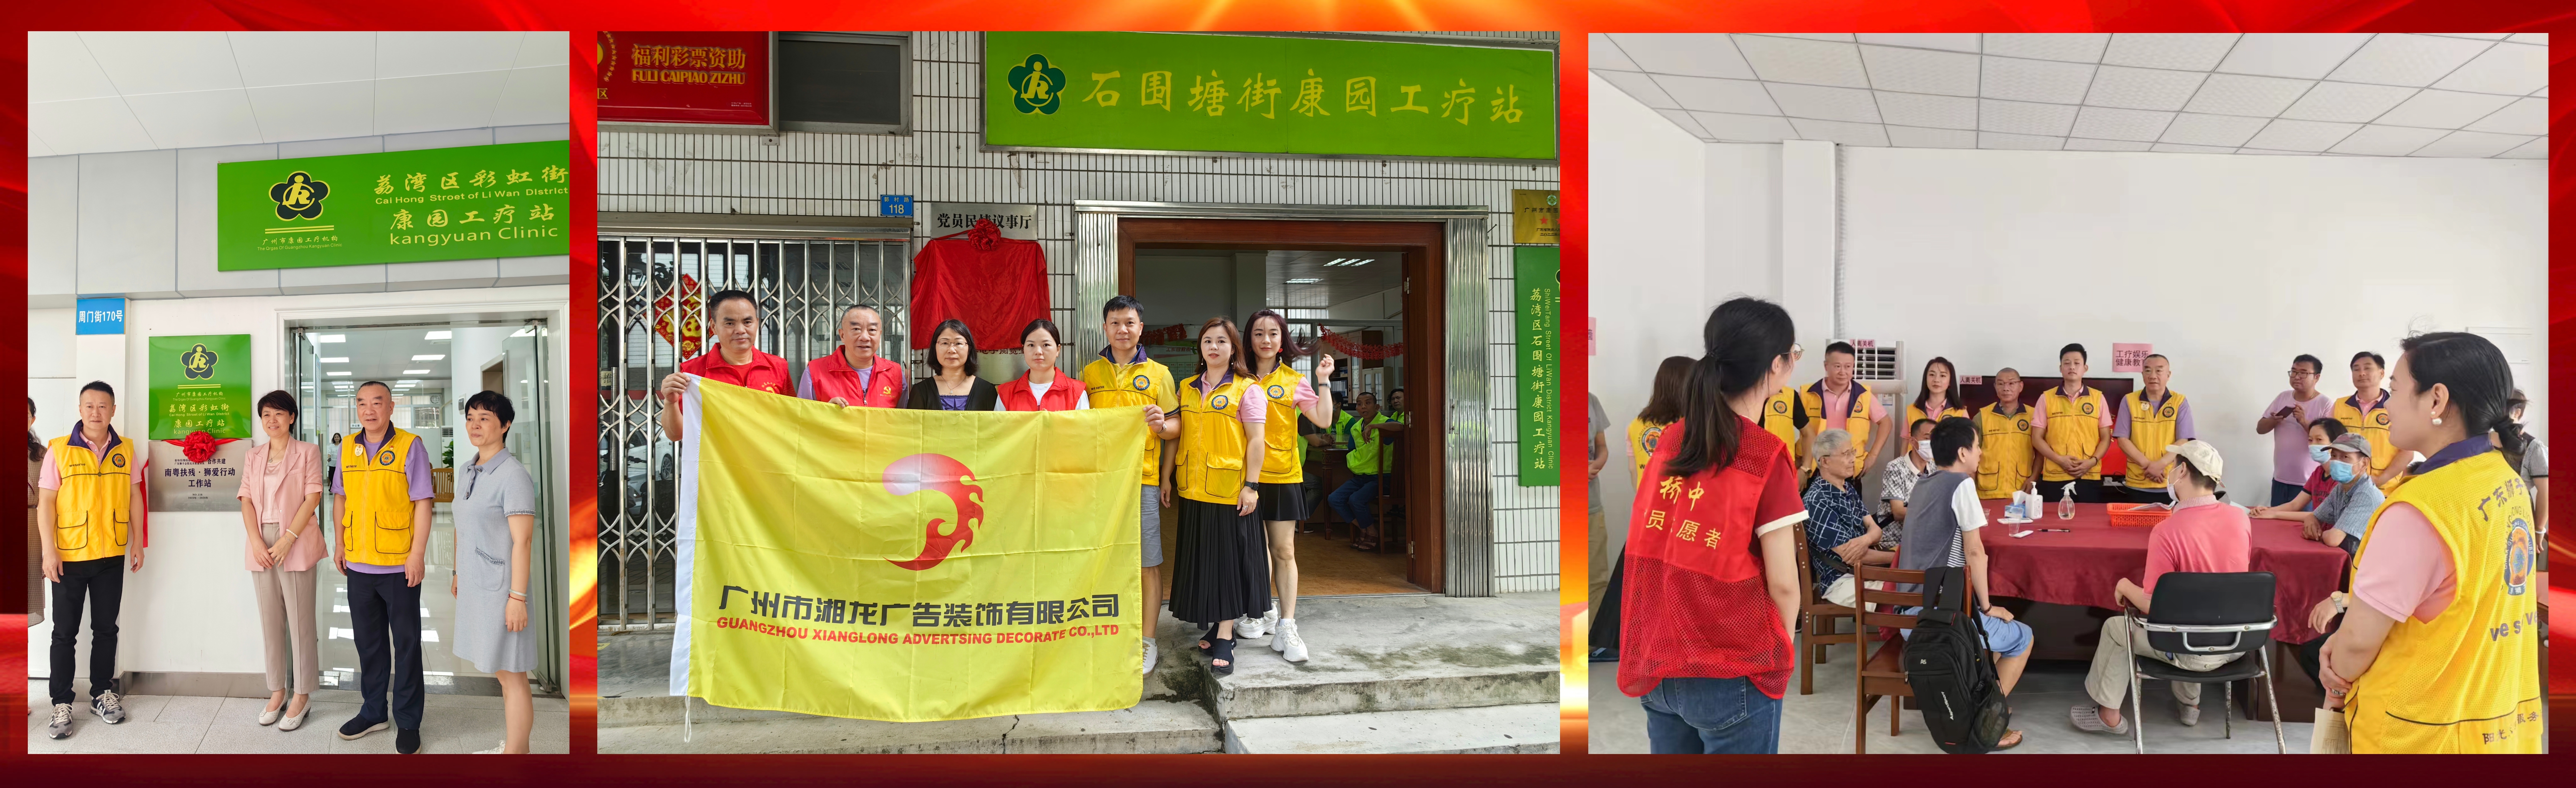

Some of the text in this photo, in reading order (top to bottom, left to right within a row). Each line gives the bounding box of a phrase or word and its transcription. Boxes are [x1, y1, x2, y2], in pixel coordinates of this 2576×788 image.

[632, 44, 746, 69] 福利彩票资助
[632, 69, 745, 84] FULI CAIPIAO ZIZHU
[1082, 69, 1523, 125] 石围塘街康园工疗站
[374, 165, 568, 195] 荔湾区彩虹街
[375, 196, 392, 205] Cai
[396, 195, 424, 205] Hong
[468, 191, 479, 199] of
[482, 191, 491, 199] Li
[495, 190, 520, 198] Wan
[390, 203, 555, 231] 康园工疗站
[889, 205, 904, 214] 118
[262, 236, 338, 245] 广州市康园工疗机构
[390, 225, 559, 246] kangyuan Clinic
[79, 310, 123, 323] 周门街170号
[2116, 350, 2149, 358] 工疗娱乐
[1530, 288, 1545, 469] 荔湾区石围塘街康园工疗站
[169, 403, 229, 412] 荔湾区彩虹街
[174, 419, 225, 428] 康园工疗站
[188, 479, 211, 487] 工作站
[719, 584, 1119, 628] 广州市湘龙广告装饰有限公司
[716, 616, 1119, 646] GUANGZHOU XIANGLONG ADVERTSING DECORATE CO.,LTD
